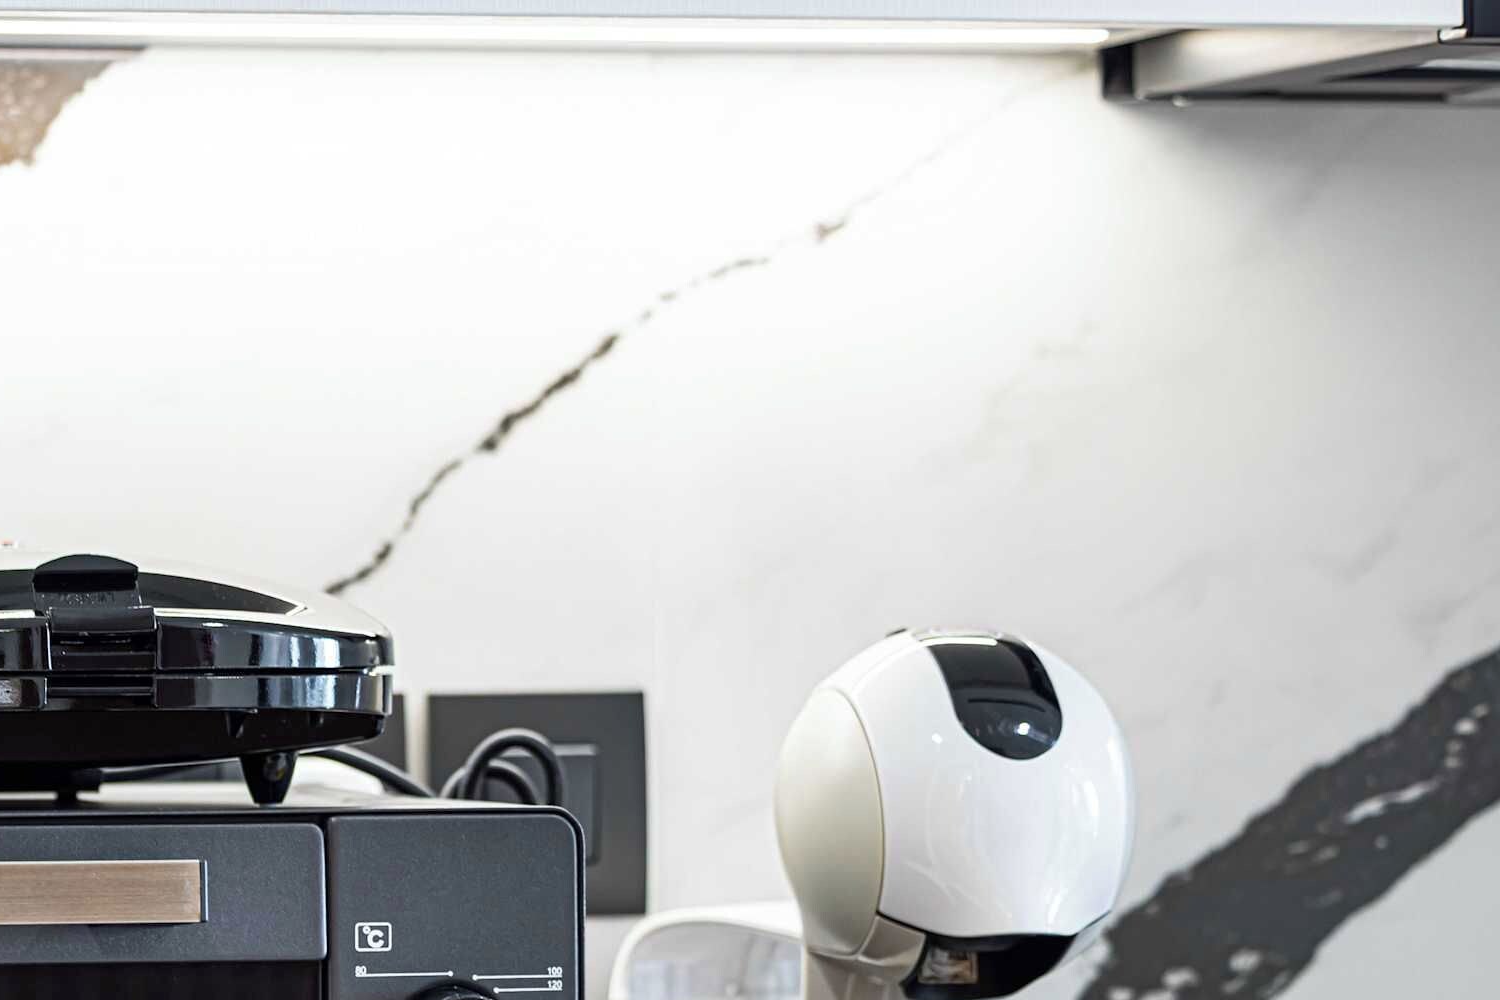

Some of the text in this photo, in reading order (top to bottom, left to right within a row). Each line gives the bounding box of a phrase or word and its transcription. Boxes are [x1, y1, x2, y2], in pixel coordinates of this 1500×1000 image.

[355, 966, 367, 976] 80
[547, 966, 563, 976] 100
[547, 980, 563, 990] 120
